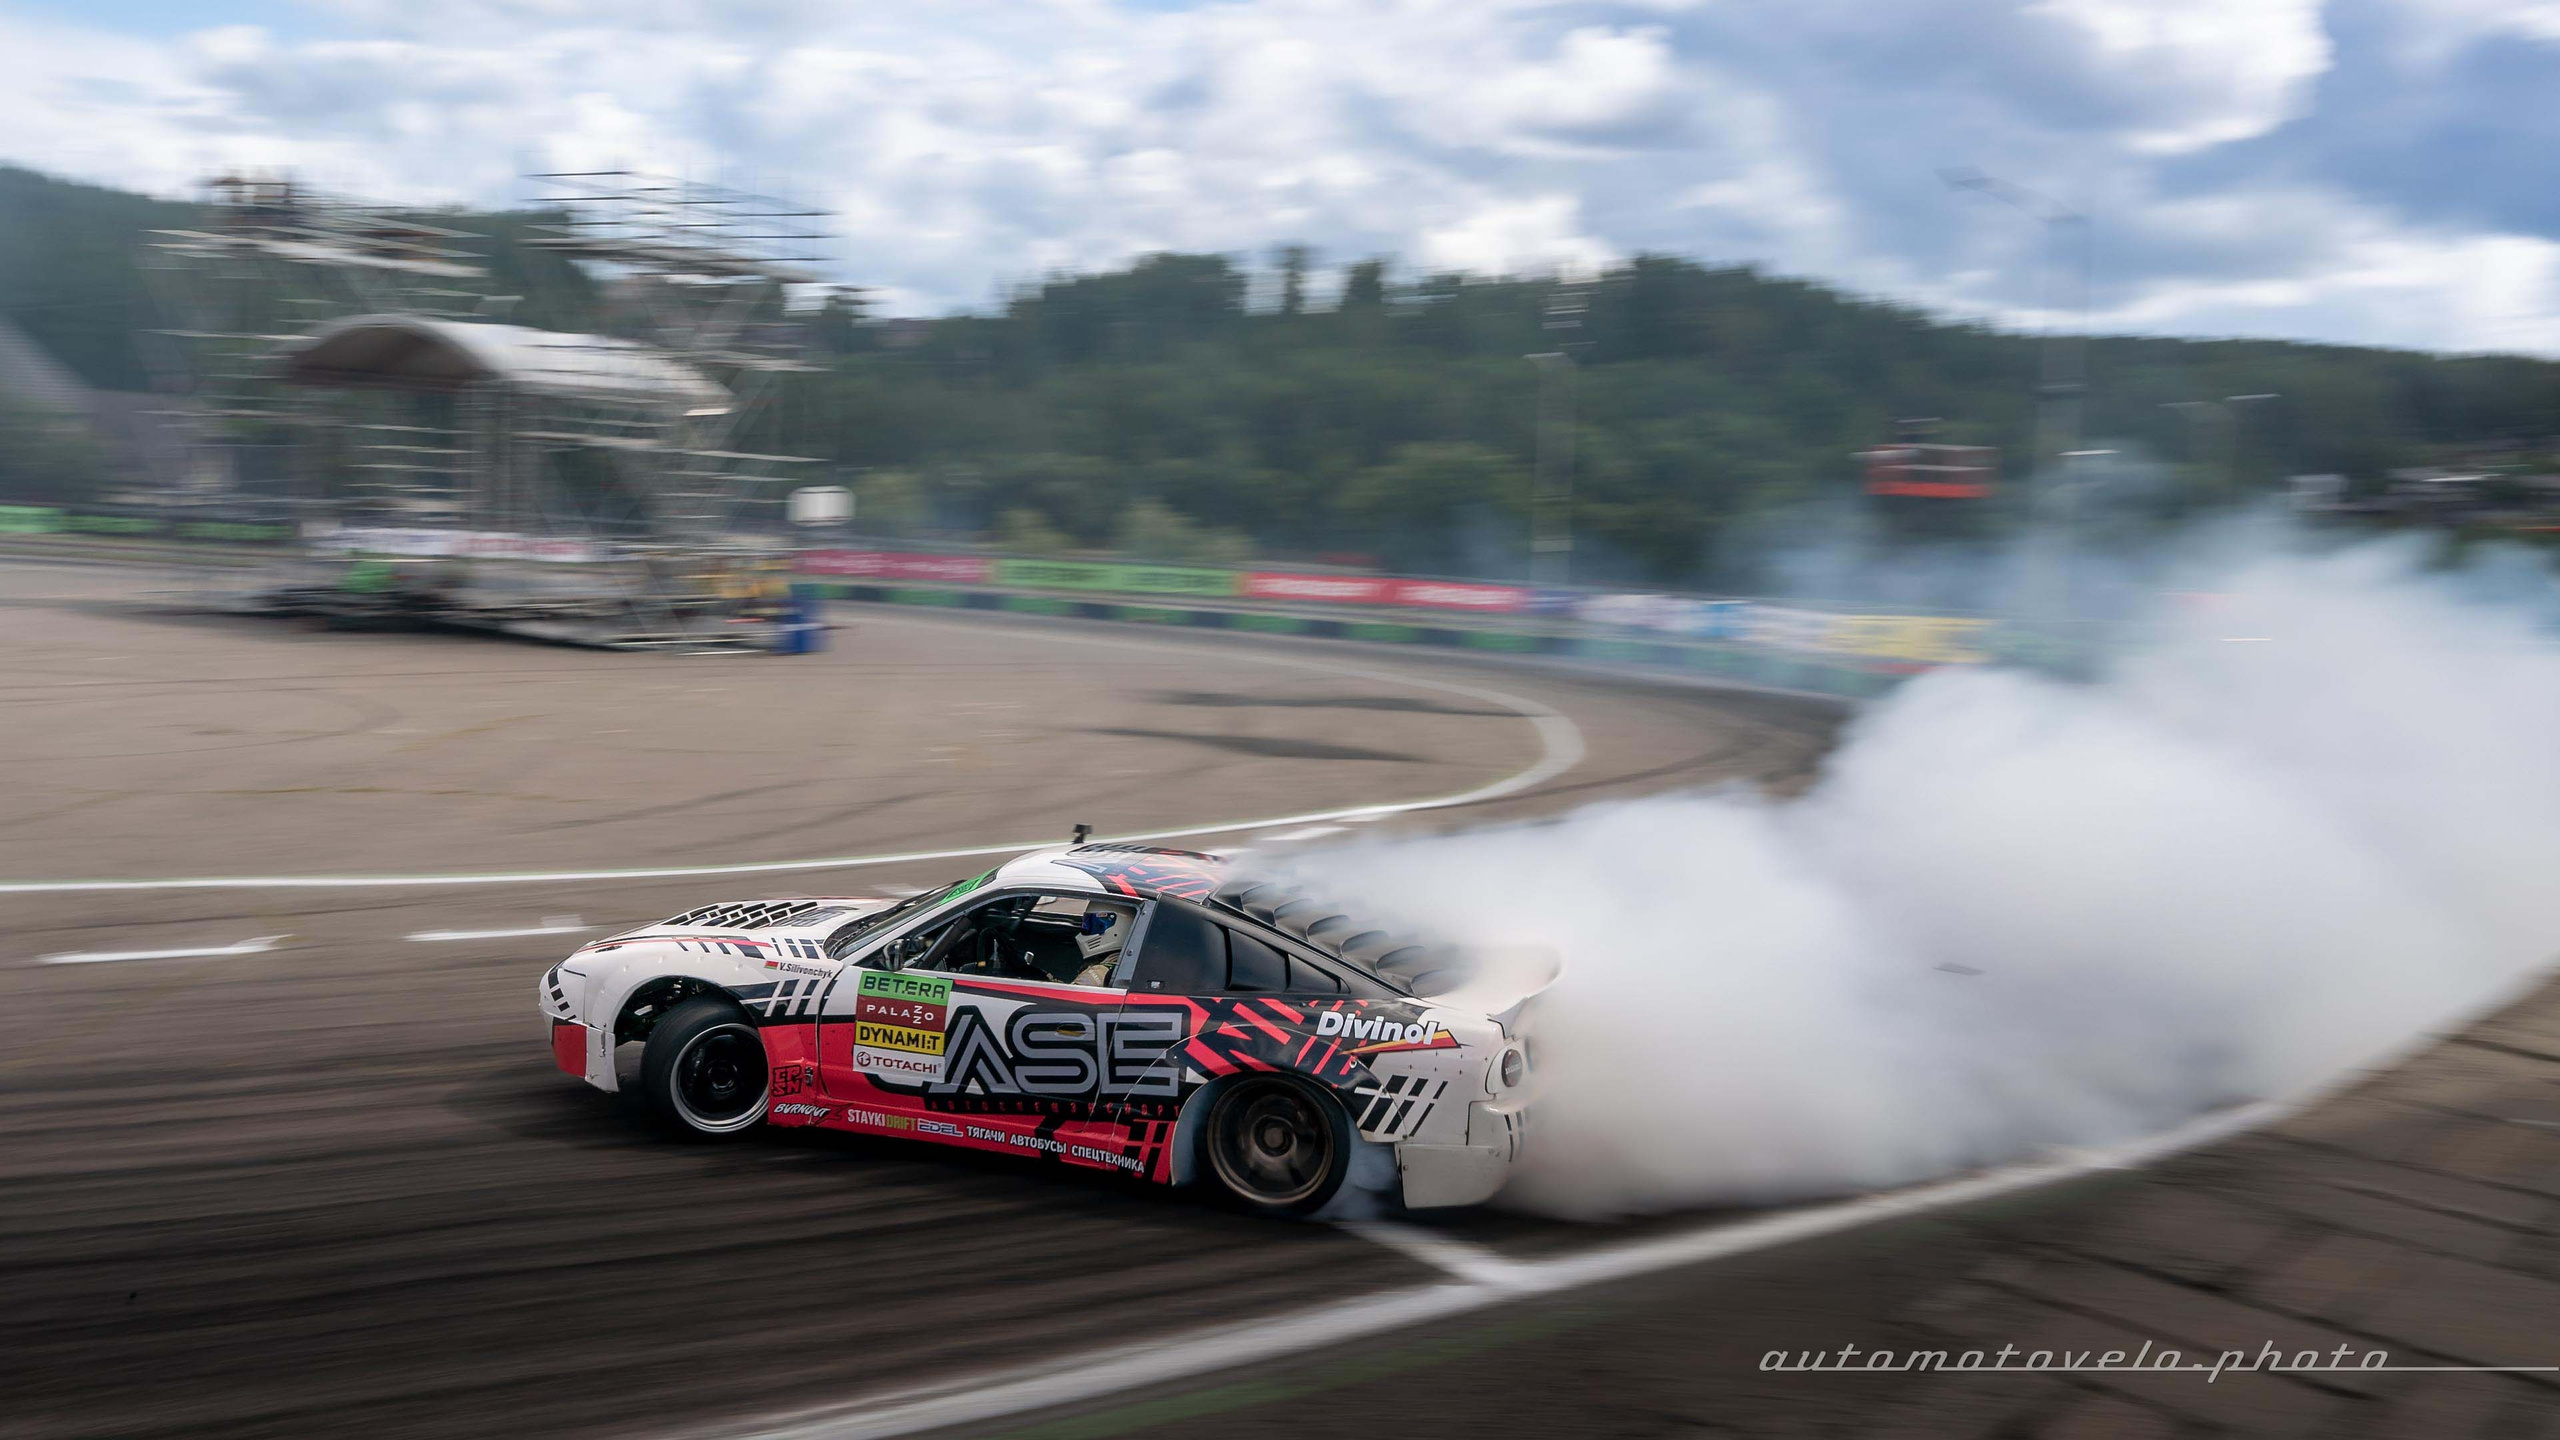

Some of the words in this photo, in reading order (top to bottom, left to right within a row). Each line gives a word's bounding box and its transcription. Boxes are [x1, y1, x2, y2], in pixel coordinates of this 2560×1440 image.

[779, 961, 833, 979] V.Silivonchyk
[1316, 1010, 1438, 1046] Divinol
[928, 1012, 1182, 1096] ASE
[873, 1056, 937, 1074] TOTACHI
[773, 1103, 832, 1118] BURNOUT
[917, 1118, 964, 1138] EDEL
[966, 1125, 1006, 1143] ТЯГАЧИ
[1009, 1133, 1067, 1154] АВТОБУСЫ
[1071, 1144, 1145, 1173] СПЕЦТЕХНИКА
